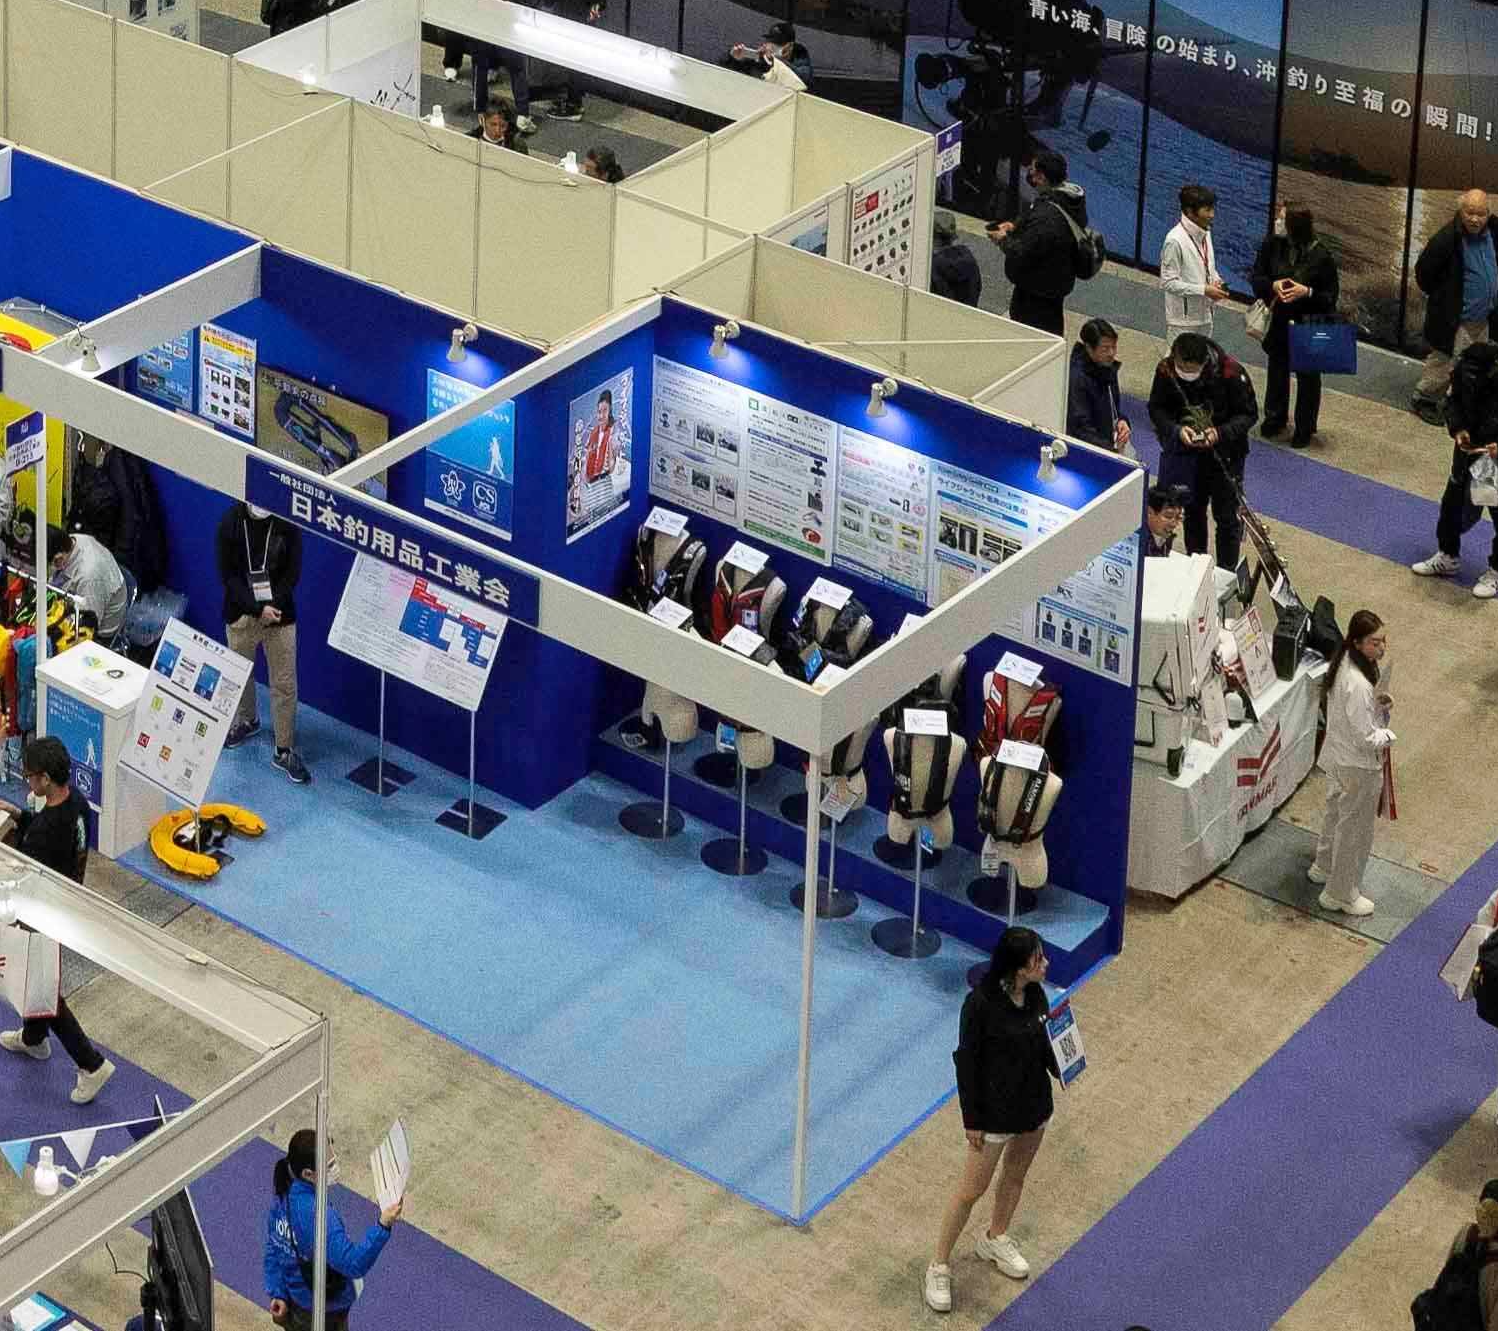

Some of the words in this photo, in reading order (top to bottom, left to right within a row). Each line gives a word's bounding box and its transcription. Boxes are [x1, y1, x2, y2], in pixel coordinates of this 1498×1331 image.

[291, 492, 510, 609] 日本釣用品工業会
